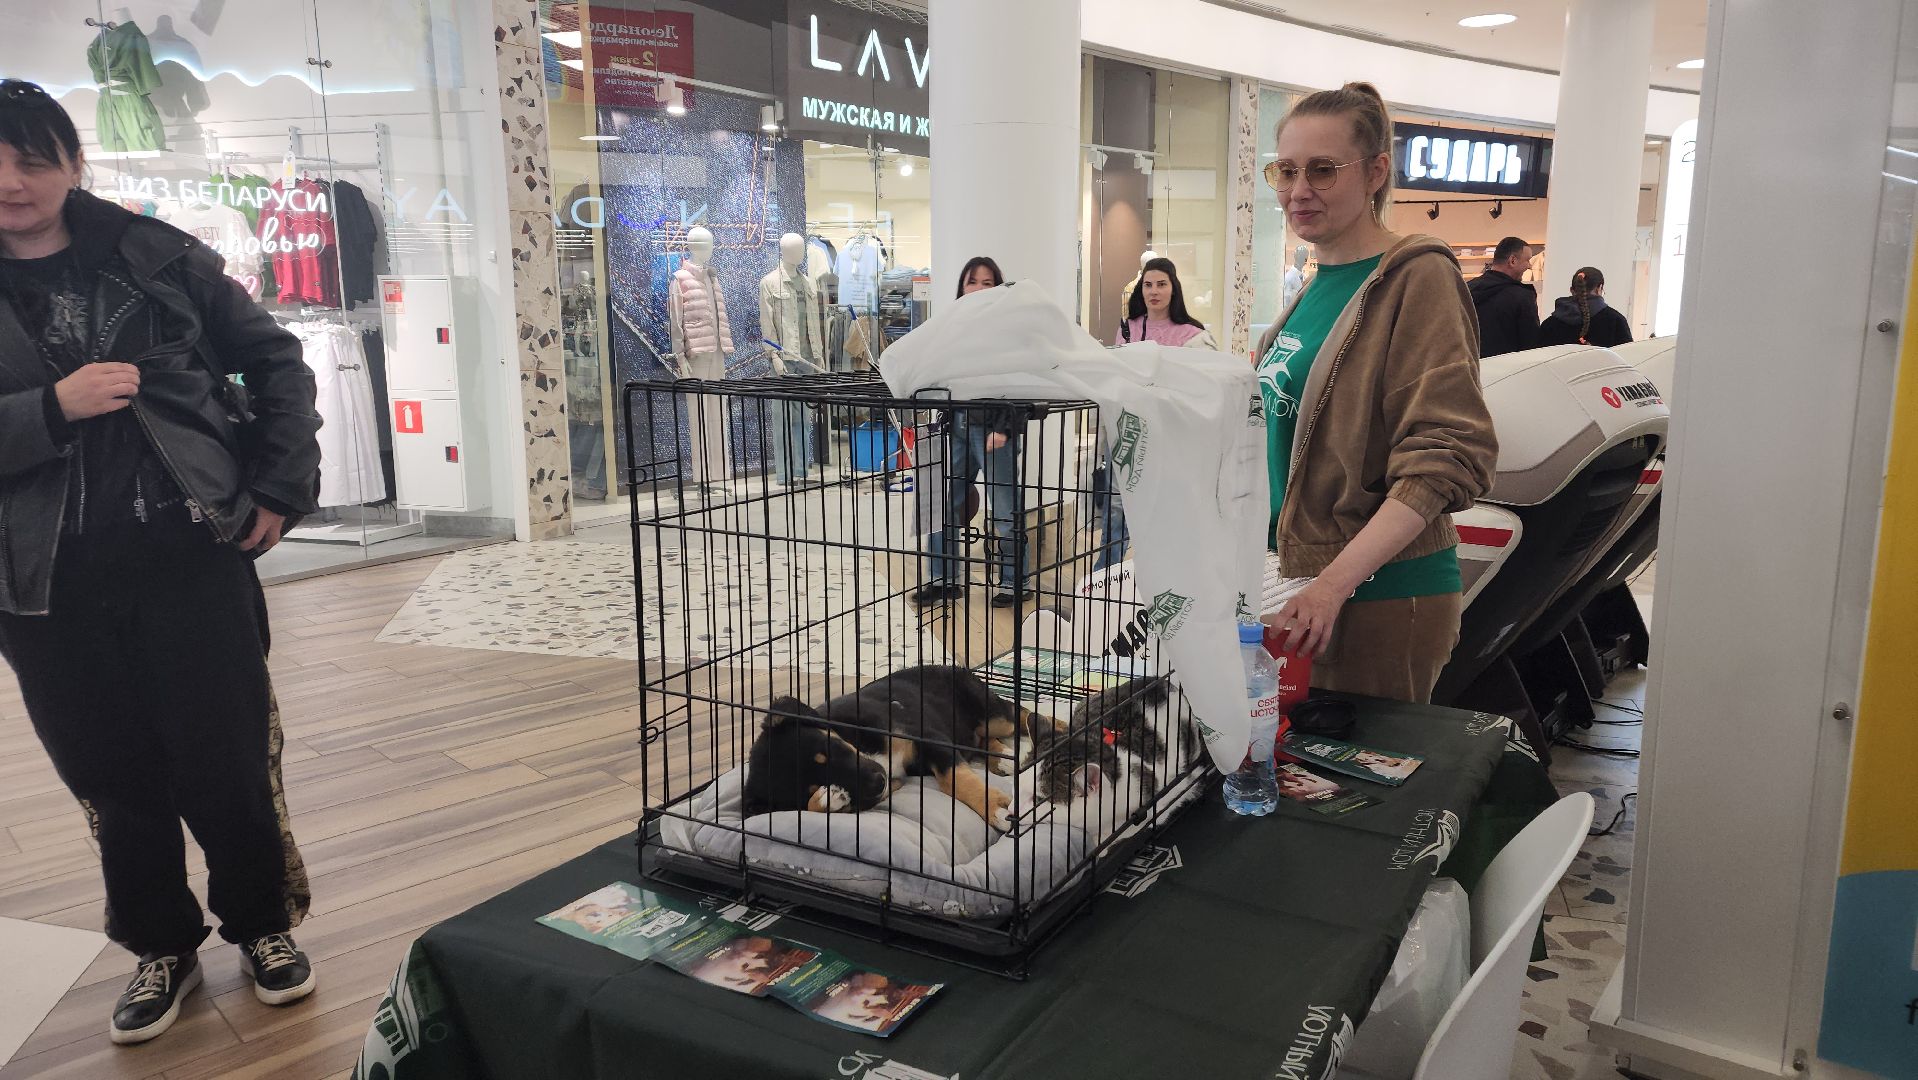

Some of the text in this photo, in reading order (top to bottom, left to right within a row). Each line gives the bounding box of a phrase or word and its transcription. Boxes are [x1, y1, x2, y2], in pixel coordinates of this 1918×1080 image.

[802, 96, 895, 132] МУЖСКАЯ
[899, 113, 911, 134] И
[1408, 135, 1522, 184] СУДАРЬ
[179, 179, 328, 213] БЕЛАРУСИ
